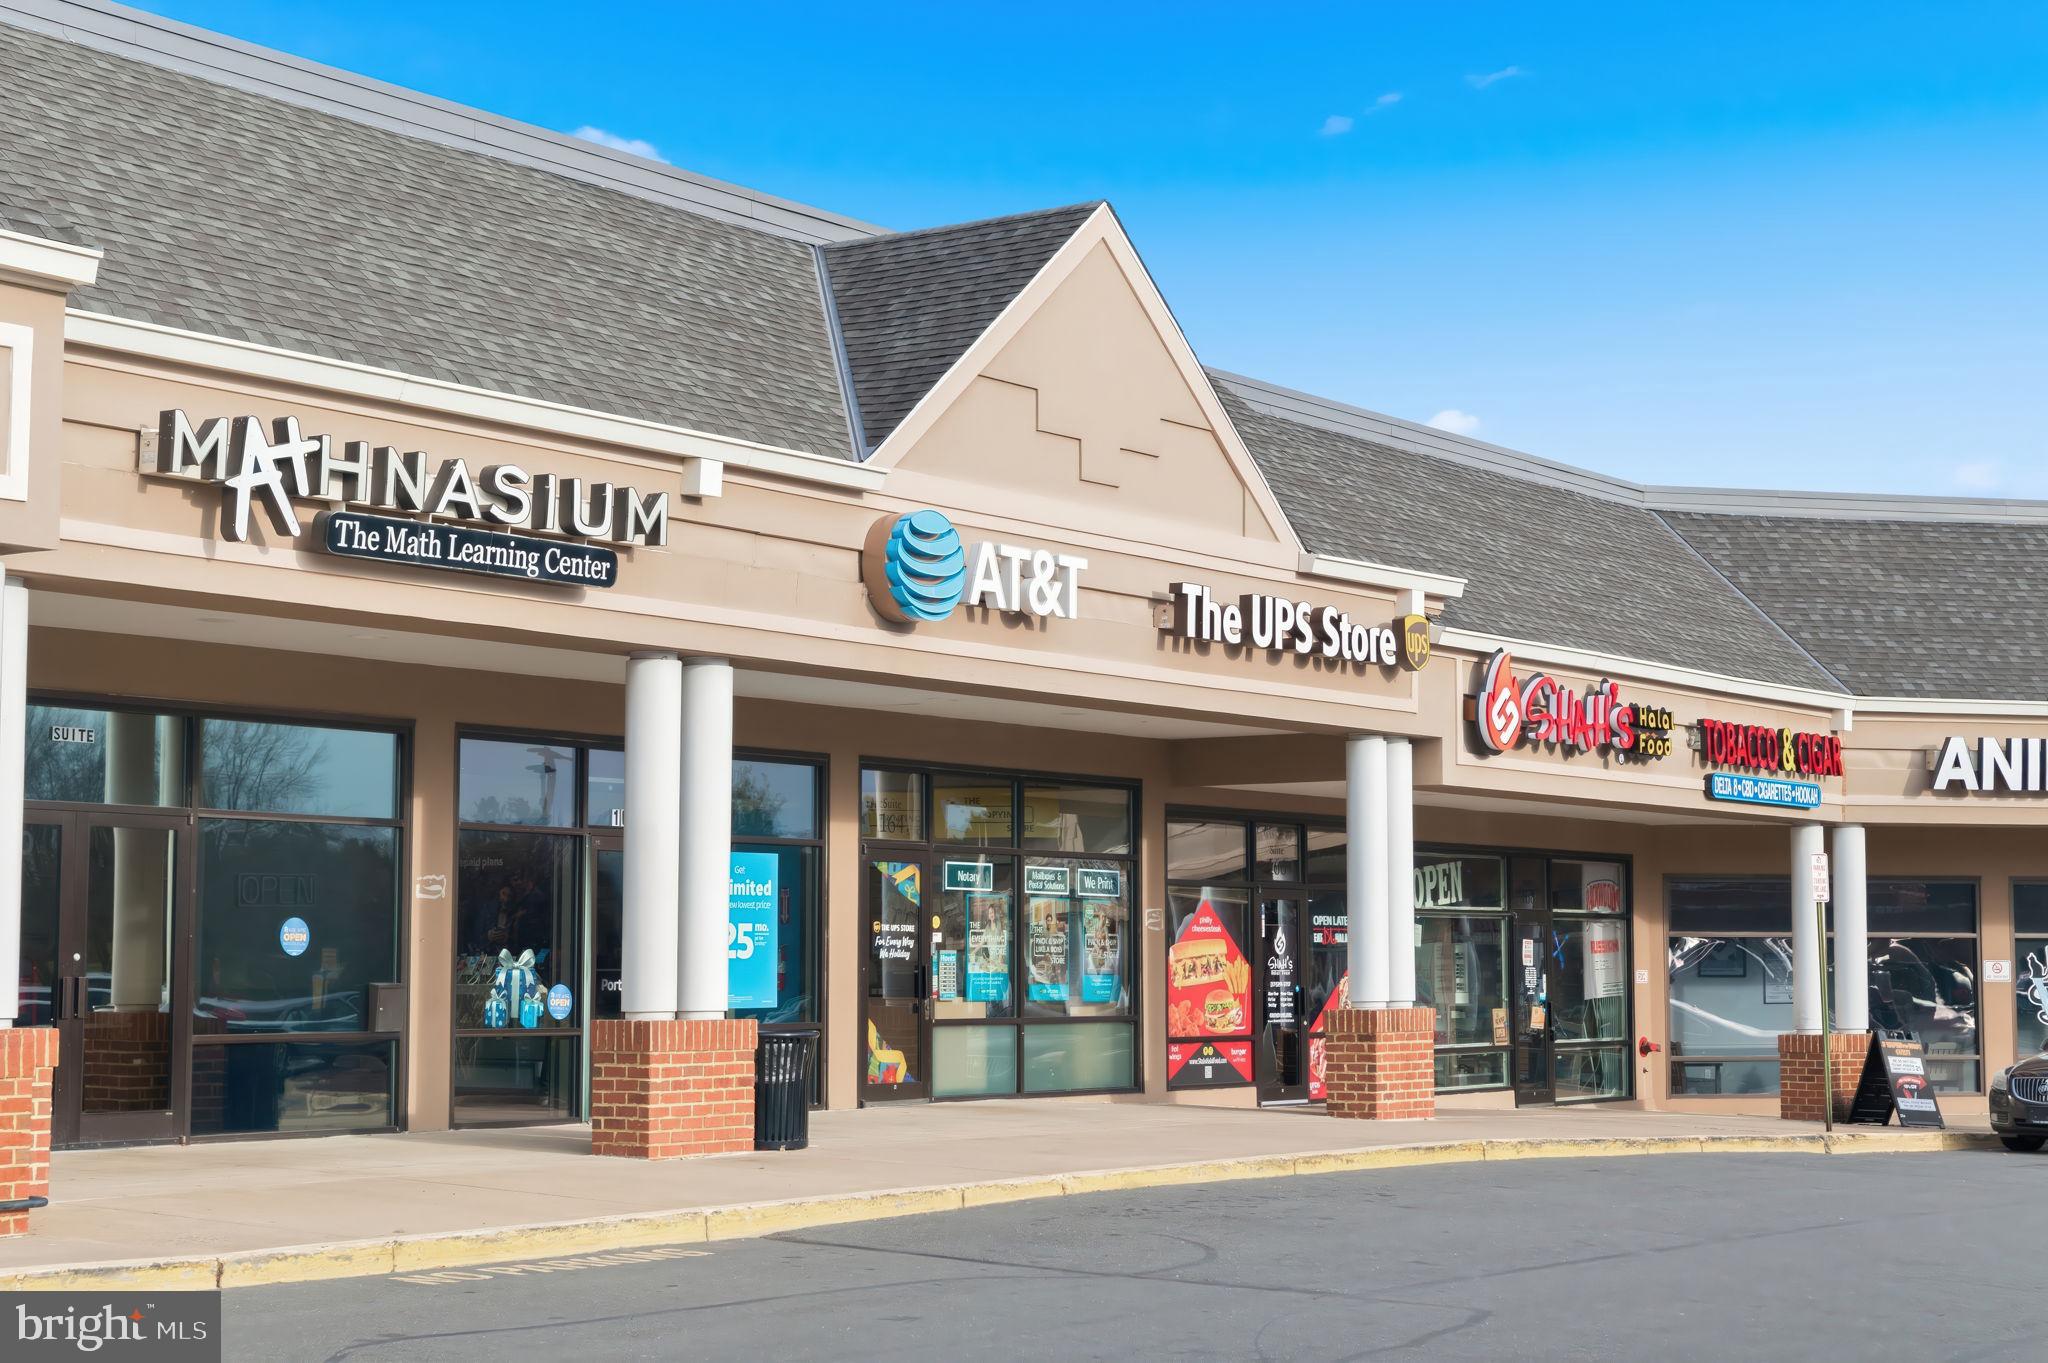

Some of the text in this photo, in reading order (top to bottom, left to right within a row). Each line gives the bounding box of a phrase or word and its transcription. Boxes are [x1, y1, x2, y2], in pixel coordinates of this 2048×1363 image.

[157, 409, 668, 545] MATHNASIUM
[335, 519, 611, 581] The Math Learning Center
[964, 541, 1088, 619] AT&T
[1174, 582, 1397, 666] The UPS Store
[1407, 631, 1428, 662] ups
[1638, 706, 1675, 730] Halal
[53, 727, 94, 742] SUITE
[1638, 733, 1673, 756] Food
[1701, 719, 1844, 776] TOBACCO & CIGAR
[1932, 736, 2048, 791] ANI
[1714, 776, 1732, 795] DELTA
[1742, 779, 1754, 798] CBD
[1757, 781, 1792, 802] CIGARETTES
[1795, 786, 1818, 804] HOOKAH
[729, 878, 772, 897] imited
[957, 870, 980, 885] Notary
[1084, 876, 1096, 889] We
[1413, 861, 1463, 909] OPEN
[1312, 915, 1333, 926] OPEN
[283, 933, 307, 942] OPEN
[388, 1247, 715, 1286] NO PARKING
